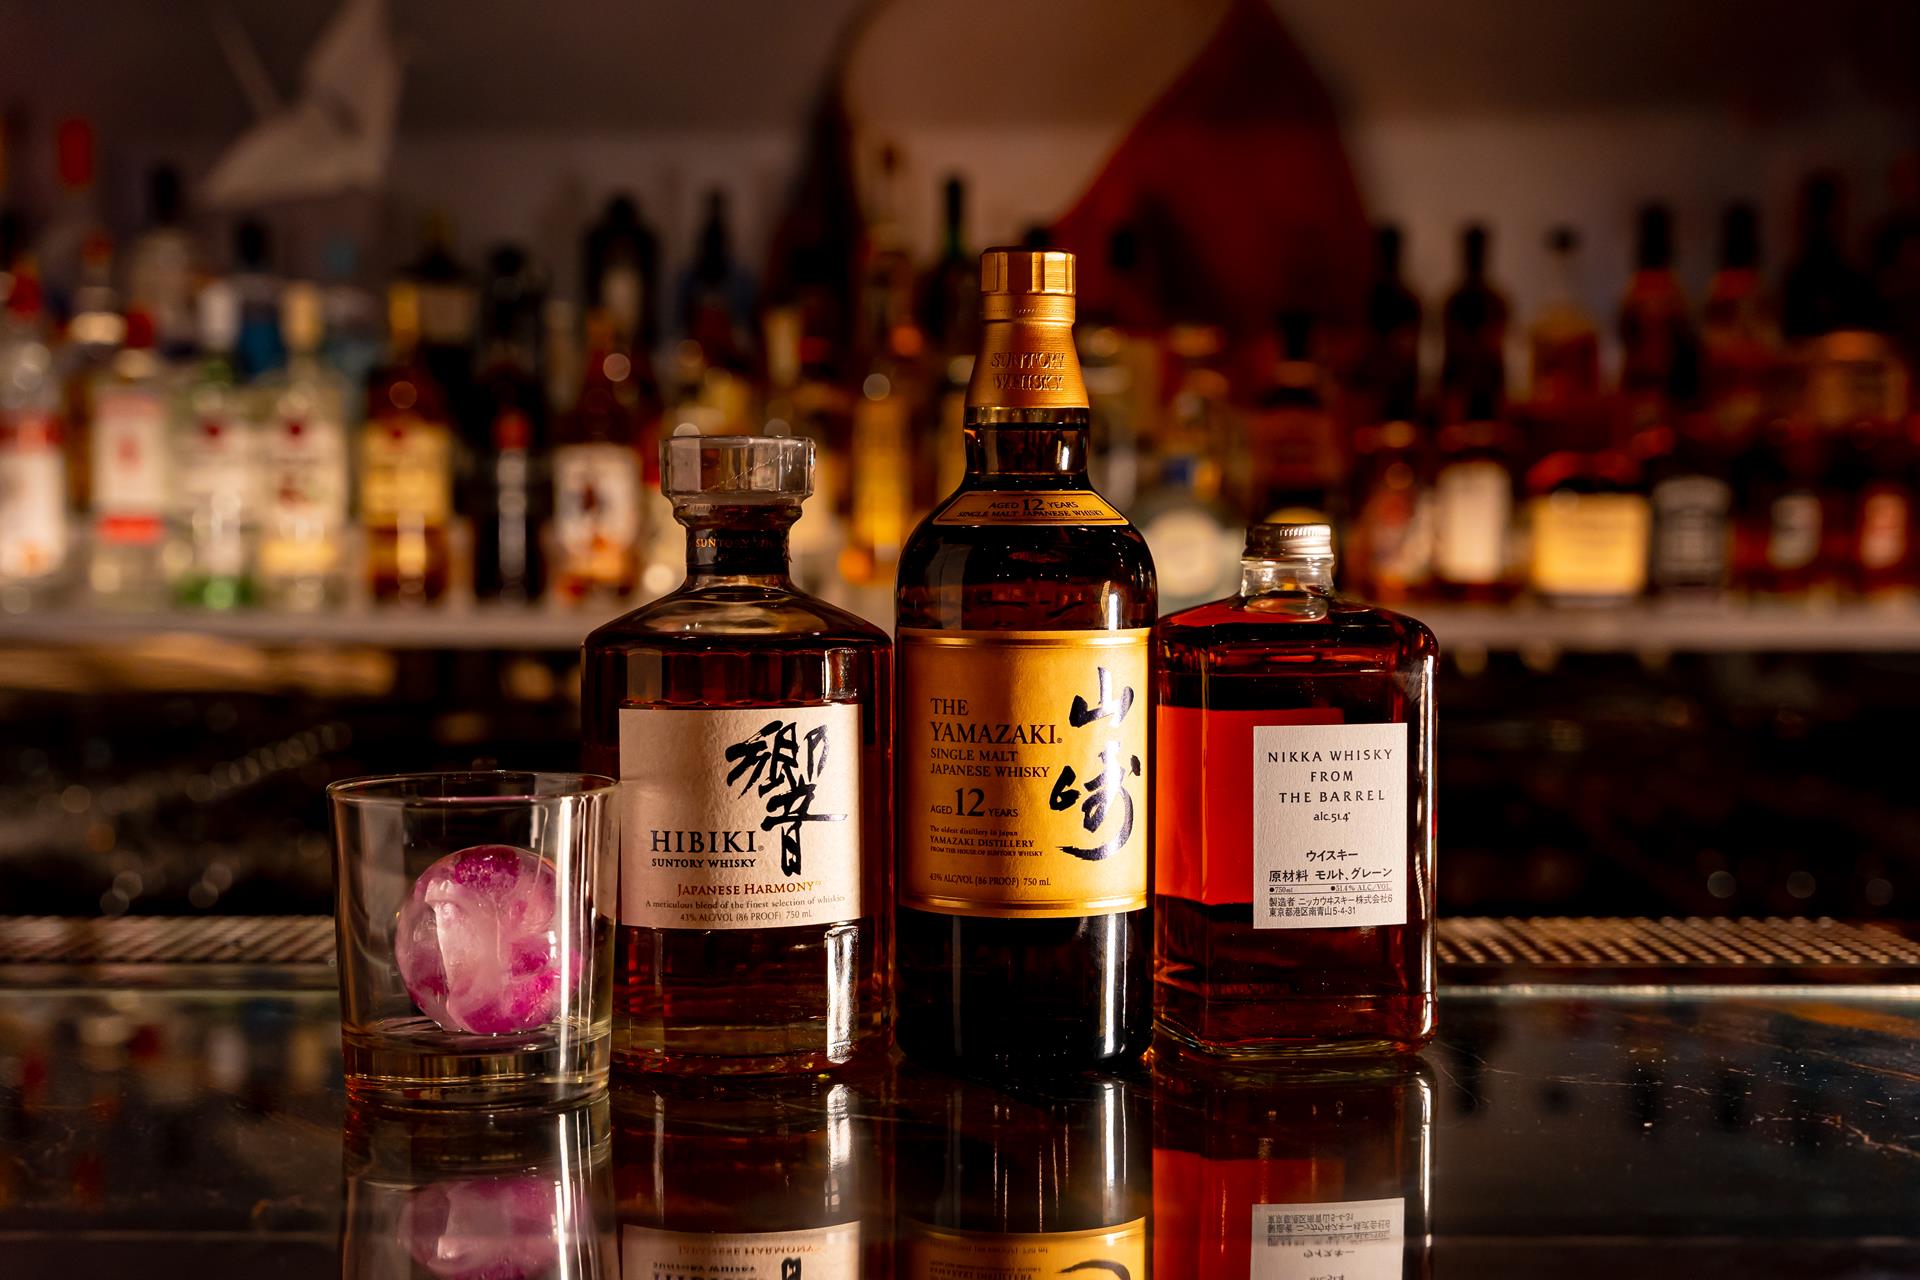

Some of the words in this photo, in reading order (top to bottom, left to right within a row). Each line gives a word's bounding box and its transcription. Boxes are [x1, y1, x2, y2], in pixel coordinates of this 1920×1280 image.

[990, 352, 1065, 370] SUNTORY
[991, 373, 1065, 391] WHISKY
[1022, 498, 1044, 511] 12
[930, 698, 969, 716] THE
[930, 721, 1056, 744] YAMAZAKI
[930, 748, 975, 761] SINGLE
[979, 750, 1018, 761] MALT
[1268, 751, 1322, 763] NIKKA
[1329, 749, 1392, 761] WHISKY
[930, 763, 991, 777] JAPANESE
[994, 766, 1050, 778] WHISKY
[1310, 770, 1353, 782] FROM
[725, 720, 848, 877] 響
[930, 804, 953, 815] AGED
[955, 787, 985, 817] 12
[987, 808, 1019, 817] YEARS
[1279, 792, 1312, 803] THE
[1319, 790, 1385, 802] BARREL
[930, 825, 939, 833] The
[941, 826, 958, 834] oldest
[959, 827, 988, 837] distillery
[998, 830, 1018, 838] Japan
[650, 830, 757, 853] HIBIKI
[930, 835, 974, 847] YAMAZAKI
[977, 840, 1035, 848] DISTILLERY
[930, 845, 944, 853] FROM
[957, 847, 977, 855] HOUSE
[1306, 849, 1358, 862] ウイスキー
[651, 858, 705, 868] SUNTORY
[705, 858, 757, 868] WHISKY
[929, 872, 943, 881] 43%
[943, 873, 974, 885] ALC/VOL
[975, 875, 987, 886] (86
[989, 876, 1020, 888] PROOF)
[1023, 877, 1038, 886] 750
[1039, 877, 1052, 886] mL
[1269, 869, 1308, 882] 原材料
[1315, 867, 1393, 881] モルト、グレーン
[677, 883, 740, 897] JAPANESE
[743, 881, 815, 895] HARMONY
[652, 901, 694, 909] meticulous
[695, 900, 718, 909] blend
[720, 900, 730, 909] of
[731, 900, 743, 909] the
[746, 900, 769, 908] finest
[771, 899, 806, 908] selection
[807, 897, 815, 905] of
[1269, 897, 1295, 907] 製造者
[680, 913, 698, 921] 43%
[699, 912, 733, 922] ALC/VOL
[736, 912, 749, 922] (86
[751, 911, 781, 921] PROOF)
[786, 910, 800, 919] 750
[802, 910, 812, 918] mL
[1269, 906, 1356, 917] 東京都港区南青山5-4-31
